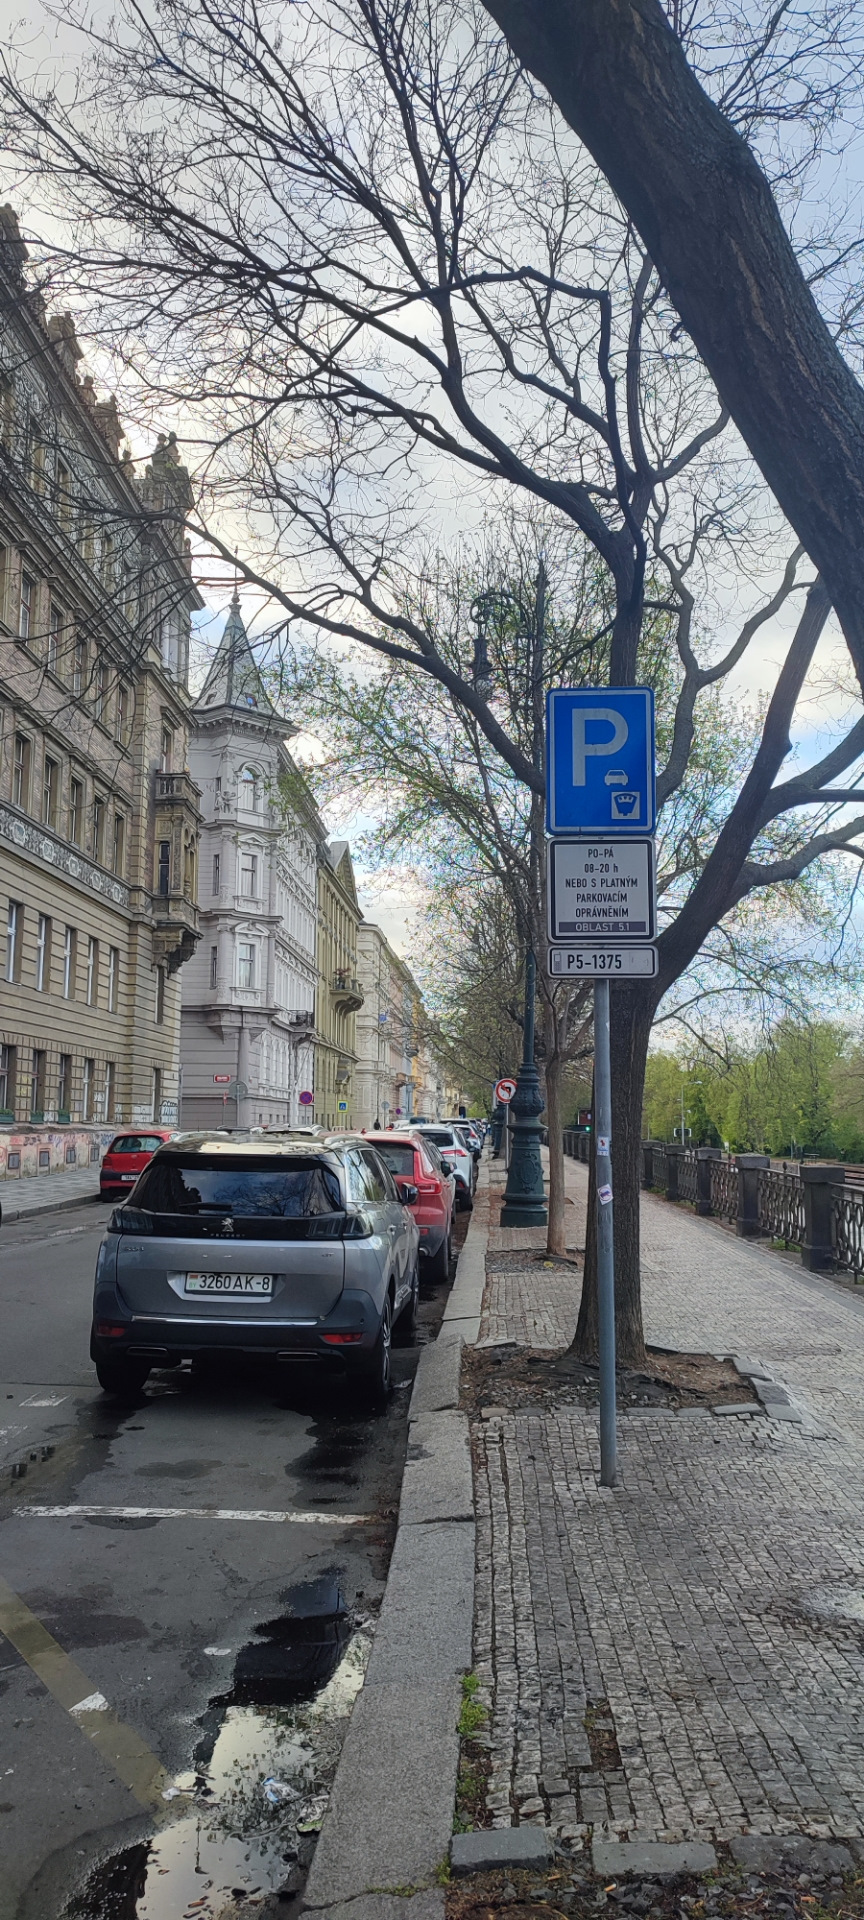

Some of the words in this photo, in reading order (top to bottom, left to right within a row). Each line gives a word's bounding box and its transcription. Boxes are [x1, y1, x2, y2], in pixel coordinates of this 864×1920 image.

[572, 708, 629, 787] P
[587, 845, 614, 858] PO-PÁ
[584, 863, 610, 873] 08-20
[613, 863, 619, 873] h
[565, 878, 588, 888] NEBO
[591, 878, 597, 888] S
[600, 875, 638, 888] PLATNÝM
[576, 890, 628, 903] PARKOVACÍM
[575, 905, 629, 918] OPRÁVNĚNÍM
[575, 922, 614, 932] OBLAST
[618, 922, 630, 932] 5.1
[567, 954, 622, 970] P5-1375
